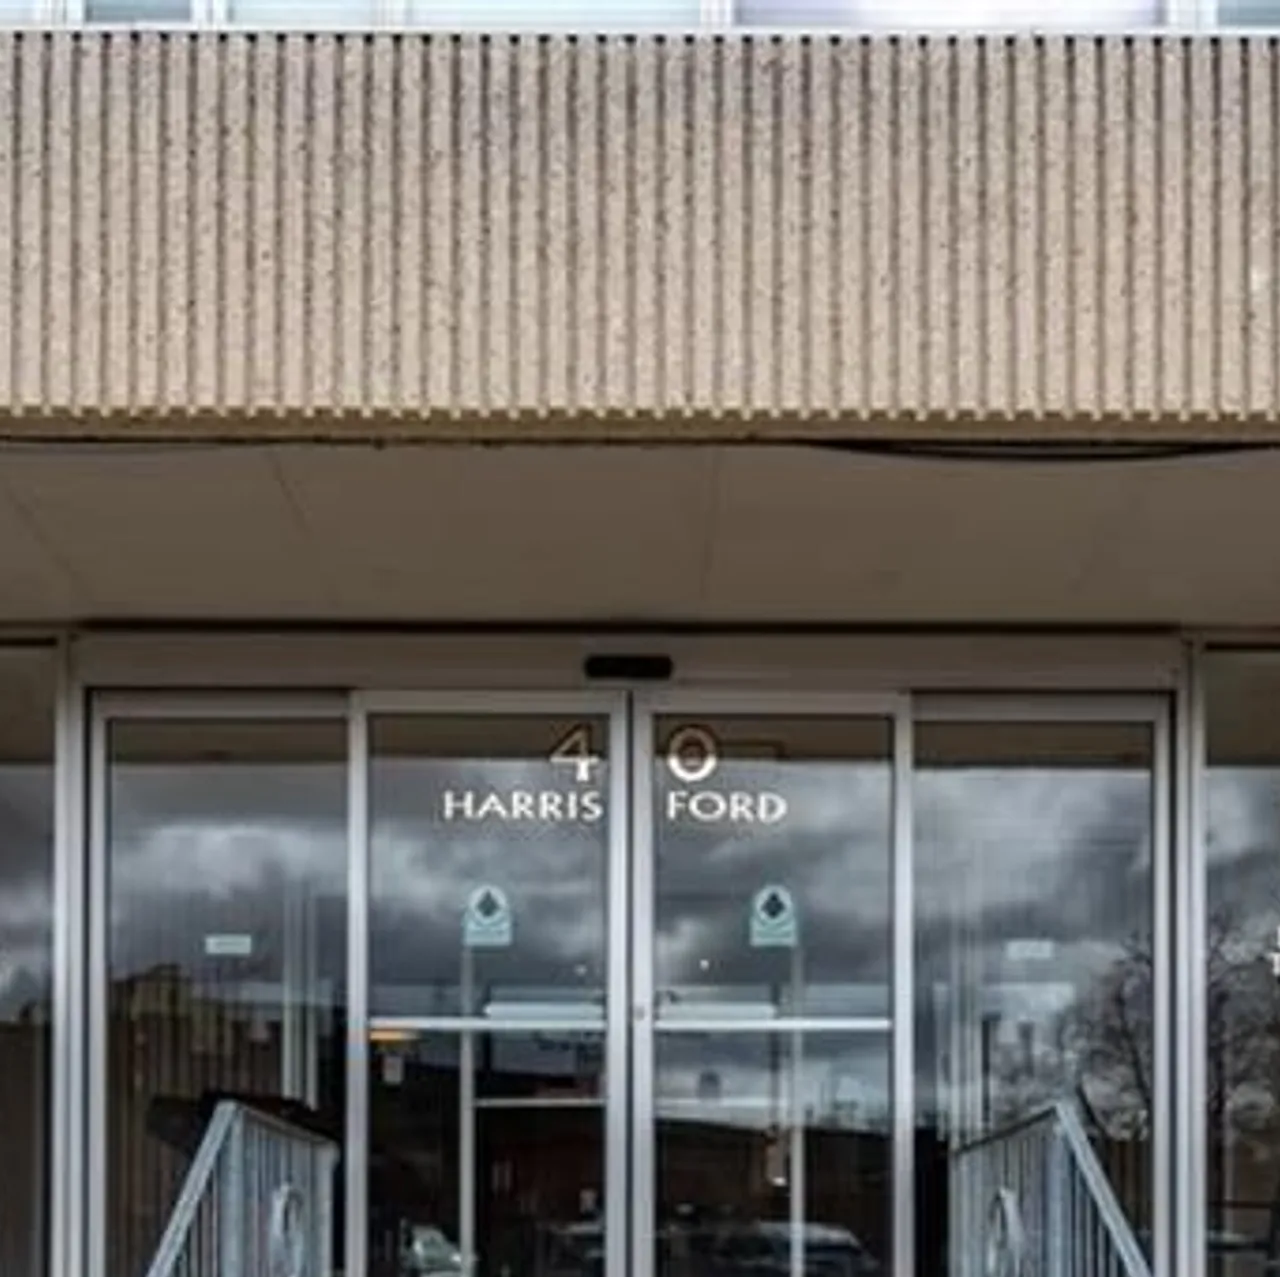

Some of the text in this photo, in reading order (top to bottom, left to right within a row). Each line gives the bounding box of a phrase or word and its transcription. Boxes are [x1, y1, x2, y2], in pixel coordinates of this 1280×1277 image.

[549, 724, 600, 782] 4
[442, 790, 788, 823] HARRIS FORD
